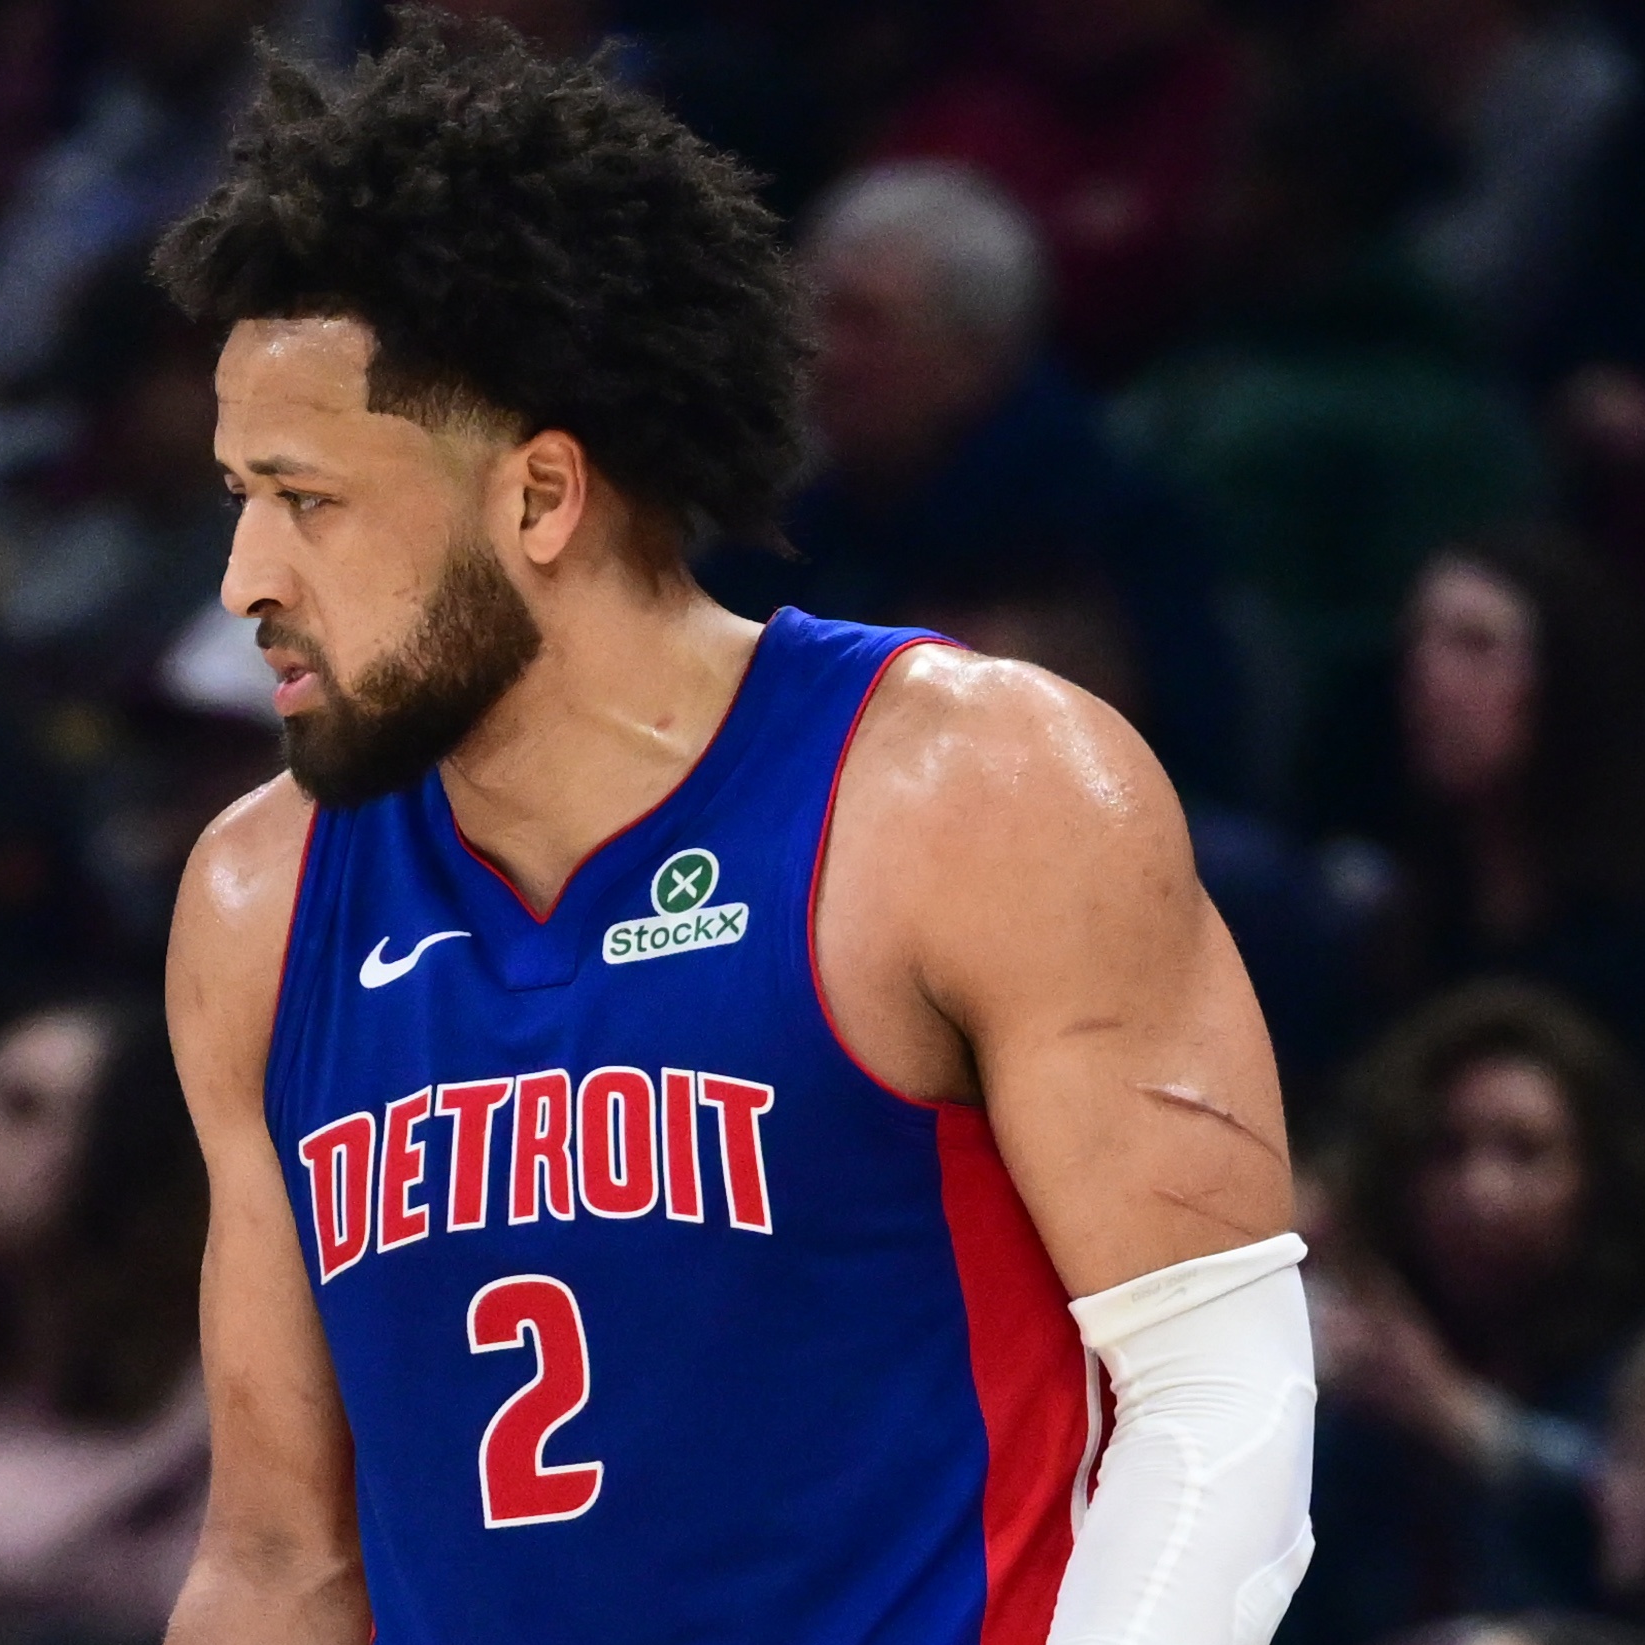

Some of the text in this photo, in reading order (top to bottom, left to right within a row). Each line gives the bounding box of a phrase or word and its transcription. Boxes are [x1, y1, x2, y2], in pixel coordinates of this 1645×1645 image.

[609, 908, 744, 957] StockX
[298, 1066, 775, 1286] DETROIT
[467, 1274, 604, 1530] 2
